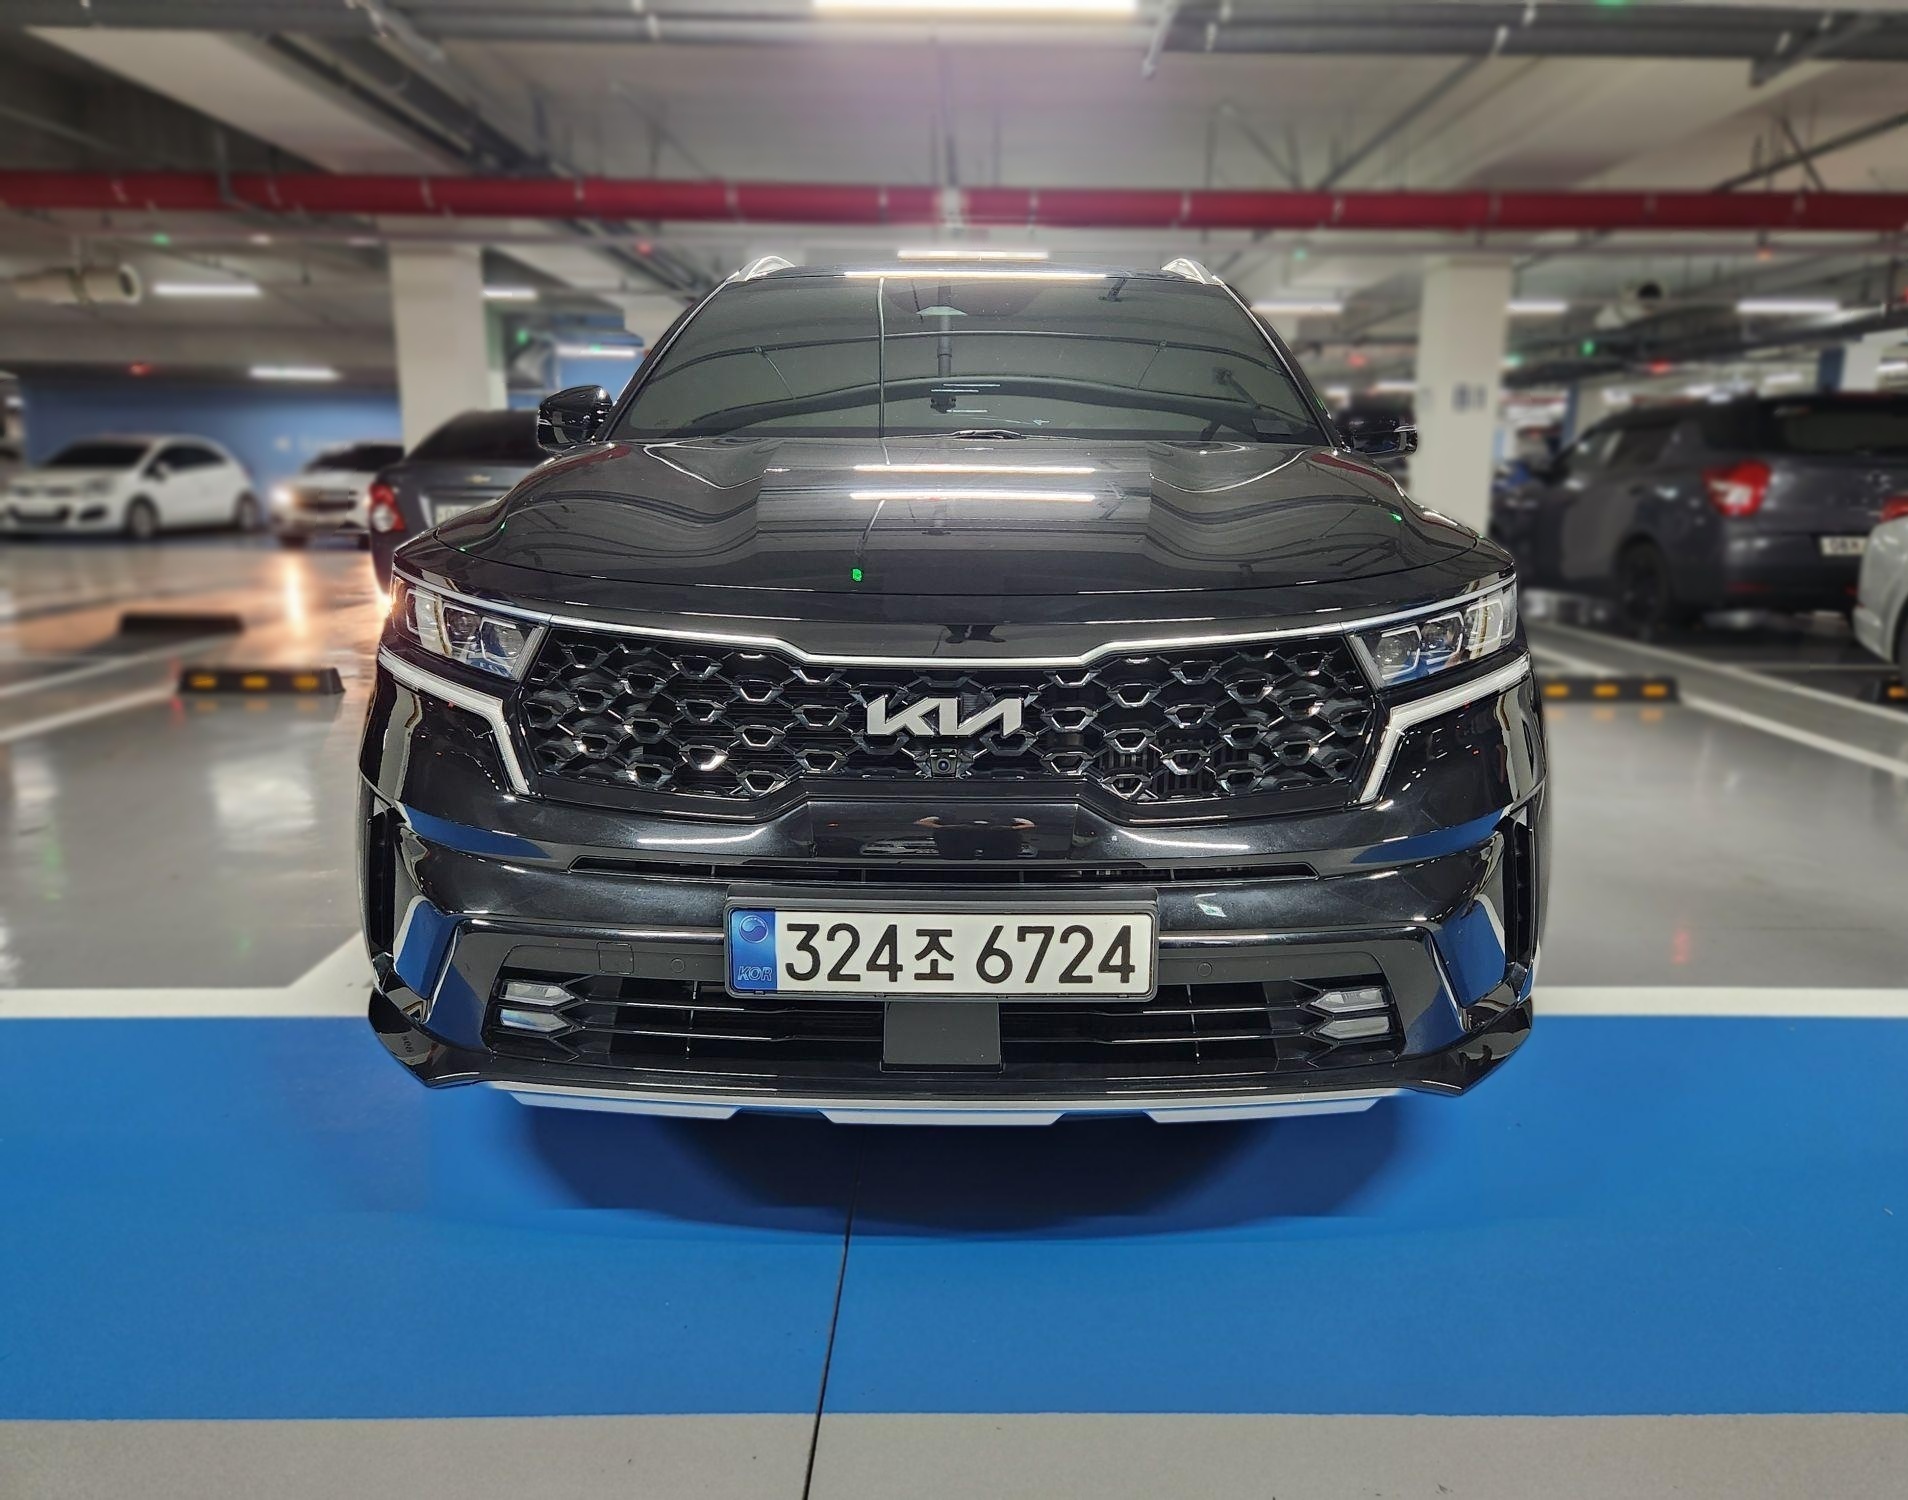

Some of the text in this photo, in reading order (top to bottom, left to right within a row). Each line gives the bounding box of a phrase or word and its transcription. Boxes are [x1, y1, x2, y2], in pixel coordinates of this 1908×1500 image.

[866, 695, 1022, 737] KIA
[737, 966, 773, 981] KOR
[785, 923, 1135, 984] 324조 6724
